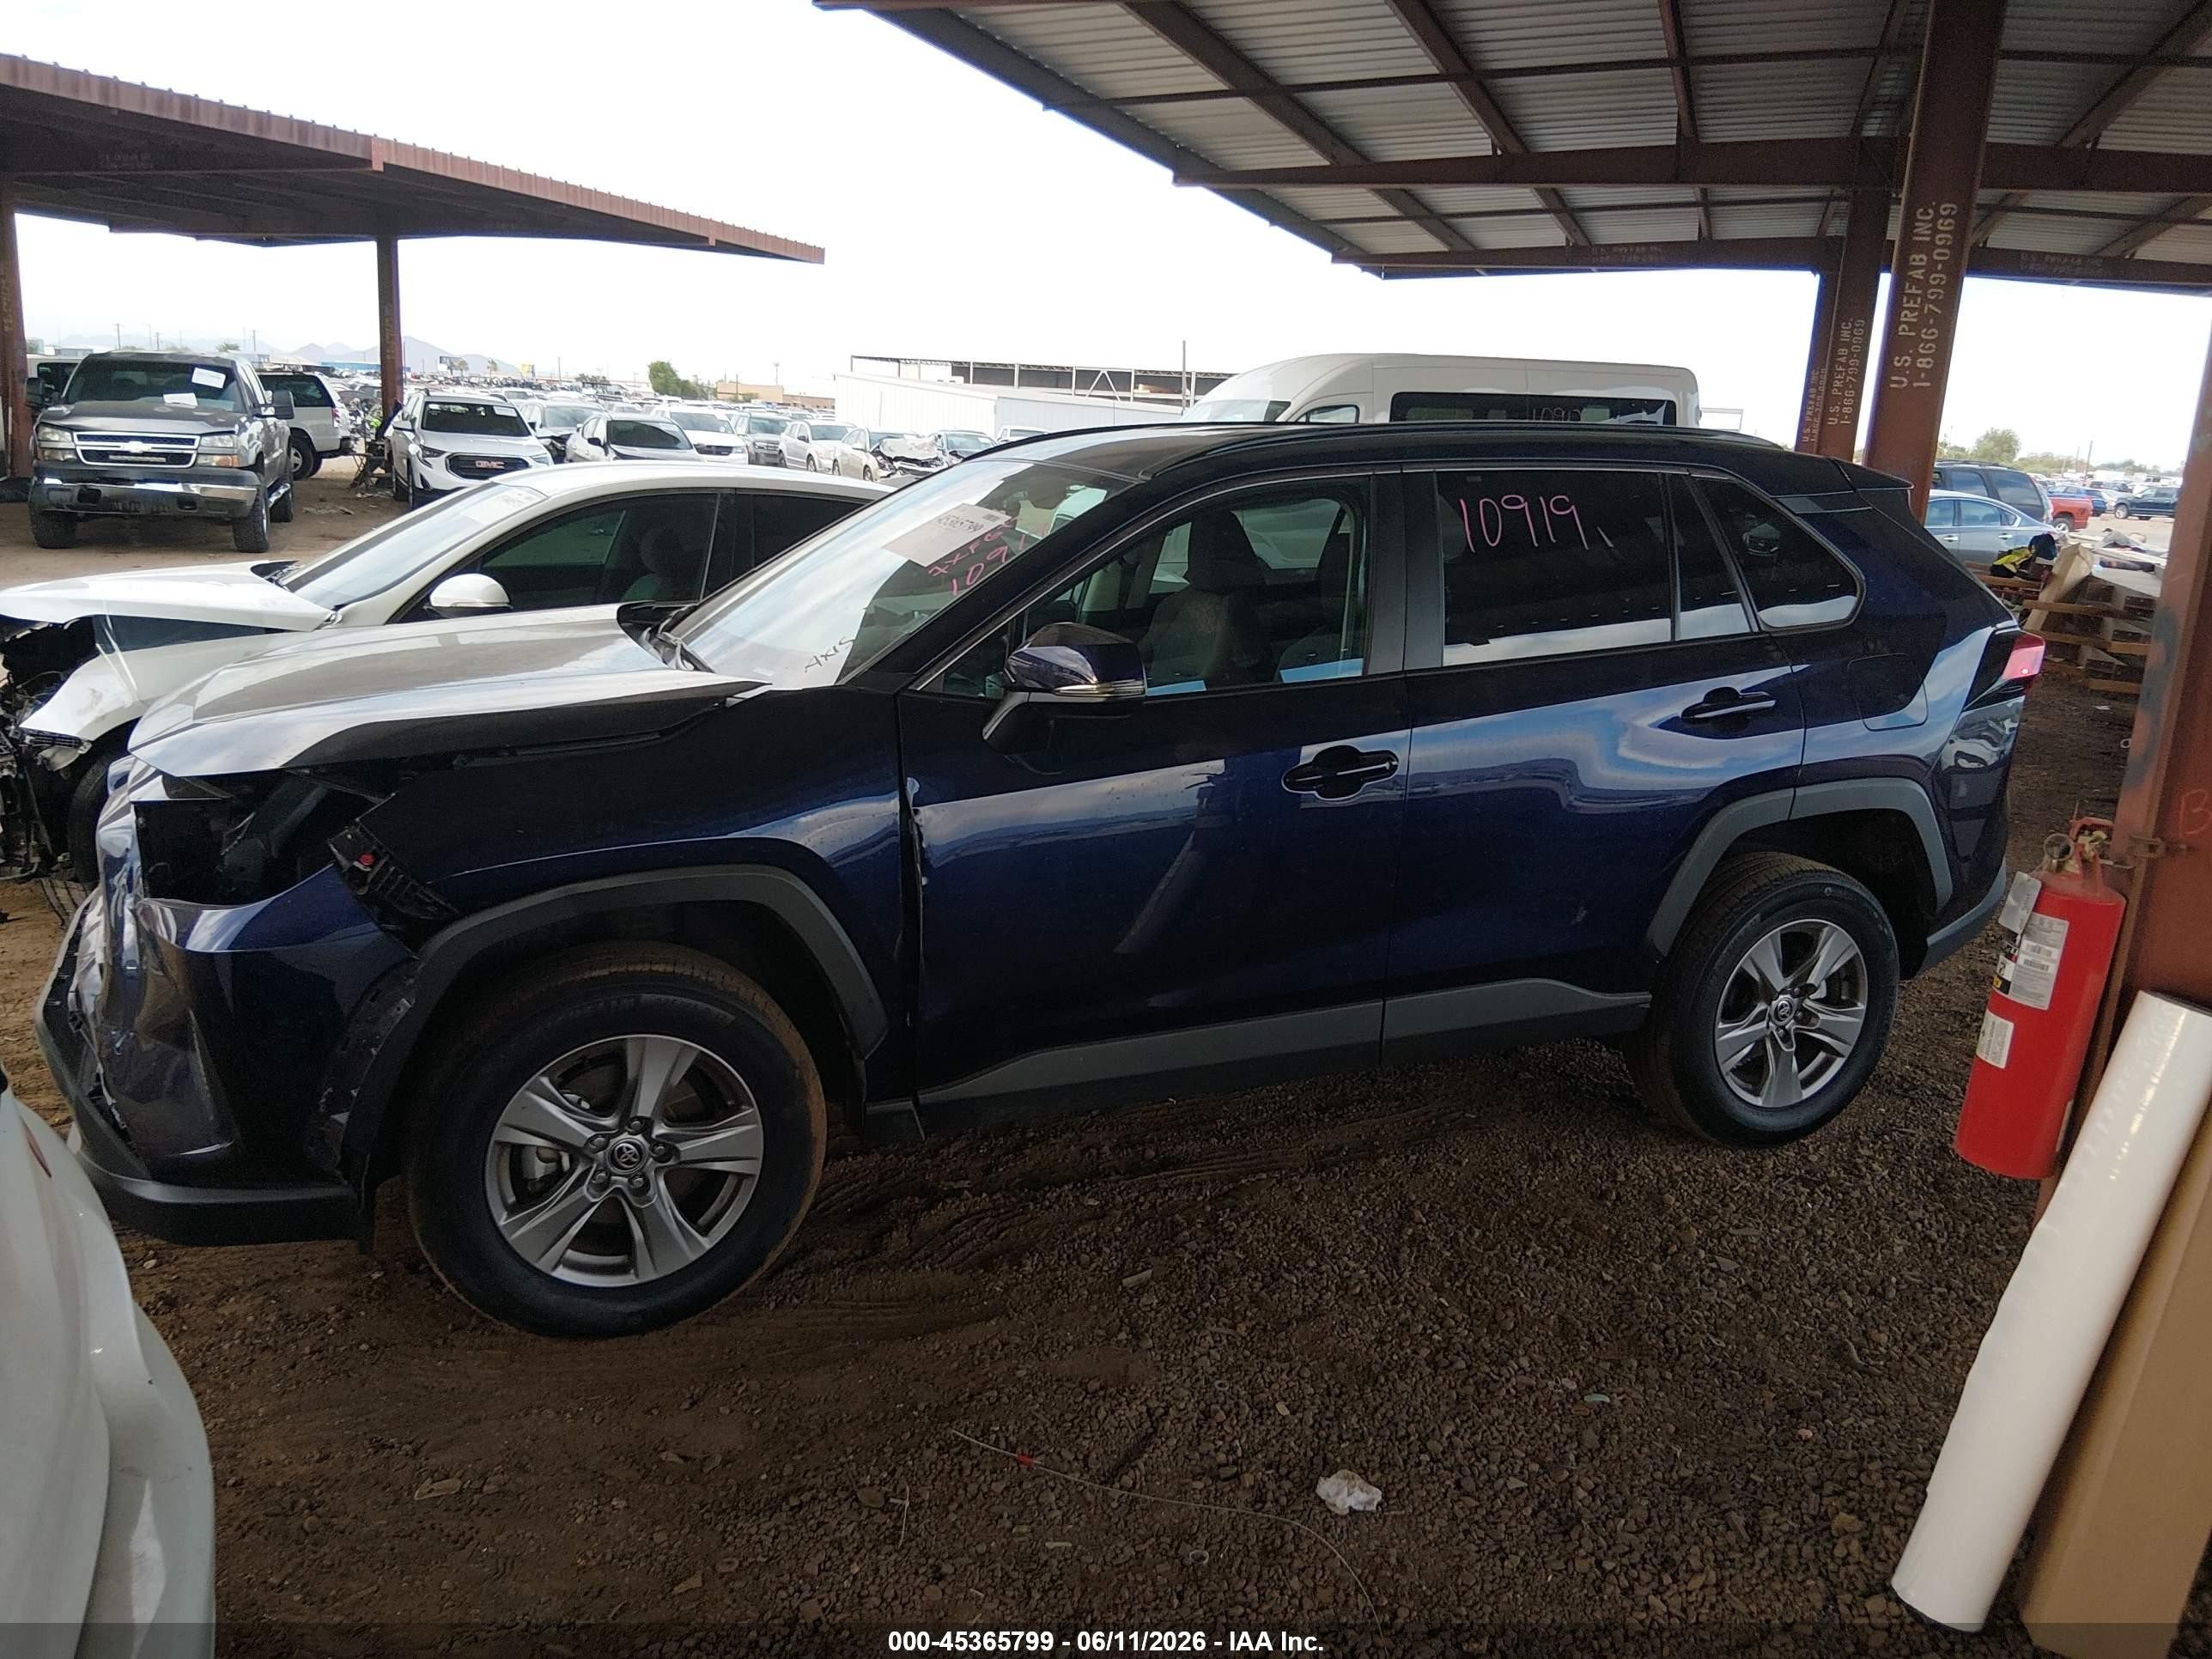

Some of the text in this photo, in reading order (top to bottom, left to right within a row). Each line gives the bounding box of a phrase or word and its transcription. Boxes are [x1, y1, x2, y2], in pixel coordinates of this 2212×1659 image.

[1889, 201, 1936, 389] U.S. PREFAB INC.
[1912, 203, 1958, 387] 1-866-799-0969
[1826, 317, 1853, 425] U.S. PREFAB INC.
[1839, 319, 1866, 424] 1-866-799-0969
[475, 460, 505, 469] GMC
